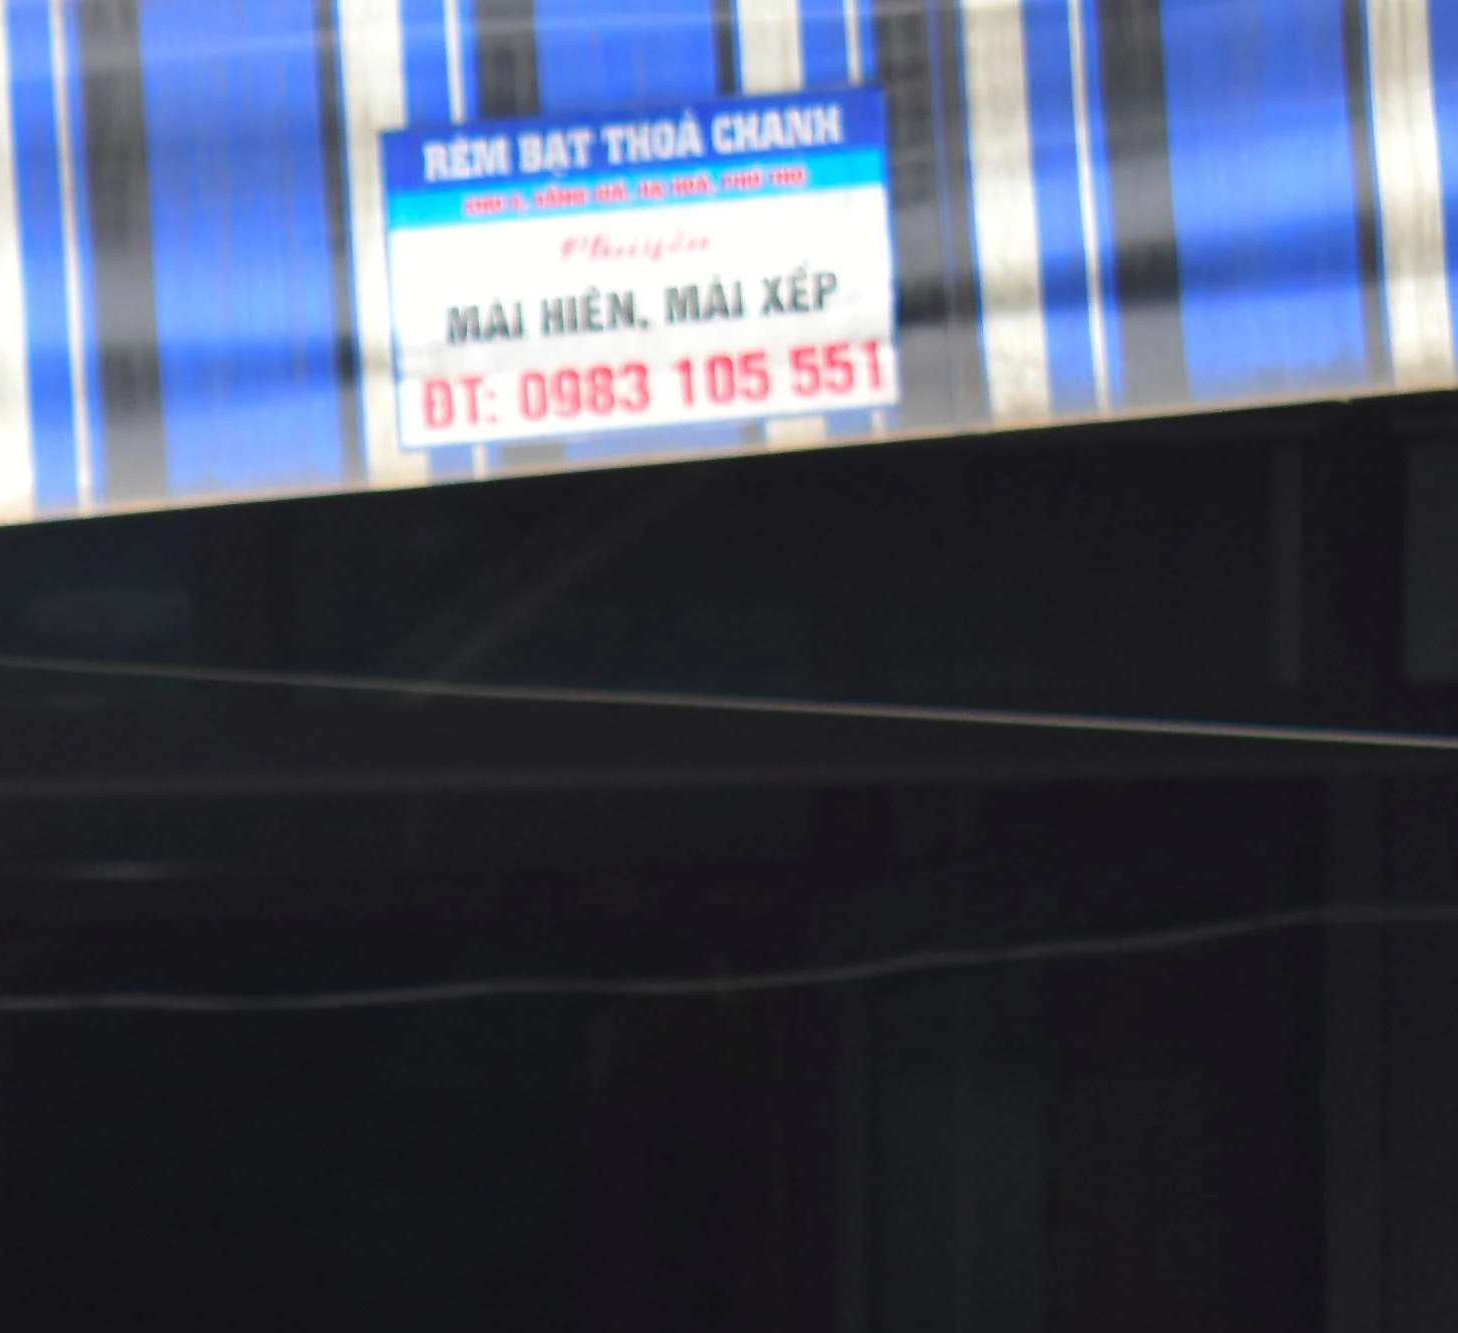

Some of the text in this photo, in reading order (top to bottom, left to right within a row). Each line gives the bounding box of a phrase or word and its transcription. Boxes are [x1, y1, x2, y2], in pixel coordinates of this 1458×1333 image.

[518, 128, 593, 176] BẠT
[711, 105, 844, 155] CHANH
[542, 284, 649, 335] HIÊN,
[761, 260, 839, 315] XẾP
[421, 338, 884, 429] ĐT: 0983 105 551
